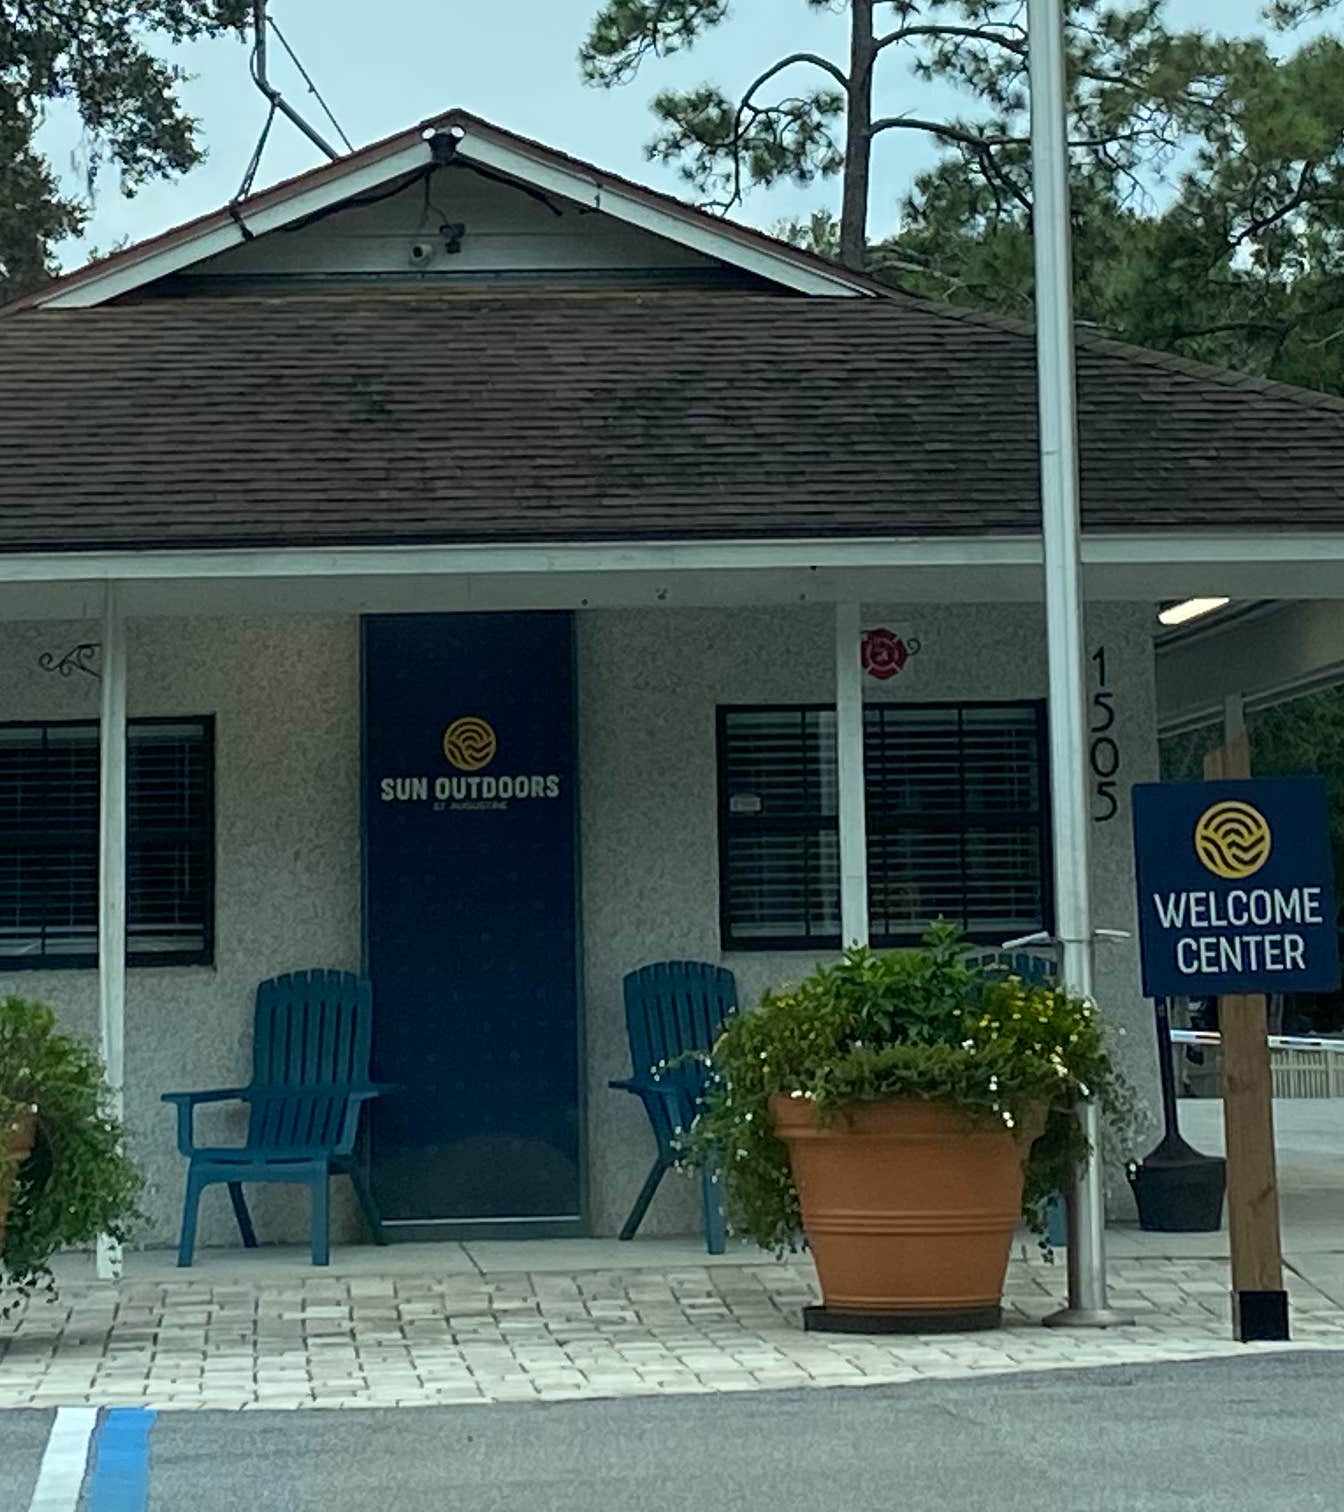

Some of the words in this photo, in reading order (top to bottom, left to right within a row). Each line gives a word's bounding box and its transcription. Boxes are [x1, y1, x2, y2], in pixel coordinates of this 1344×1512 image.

[1090, 646, 1119, 822] 1505
[380, 777, 428, 801] SUN
[435, 775, 560, 800] OUTDOORS
[1153, 887, 1323, 929] WELCOME
[1176, 934, 1307, 975] CENTER
